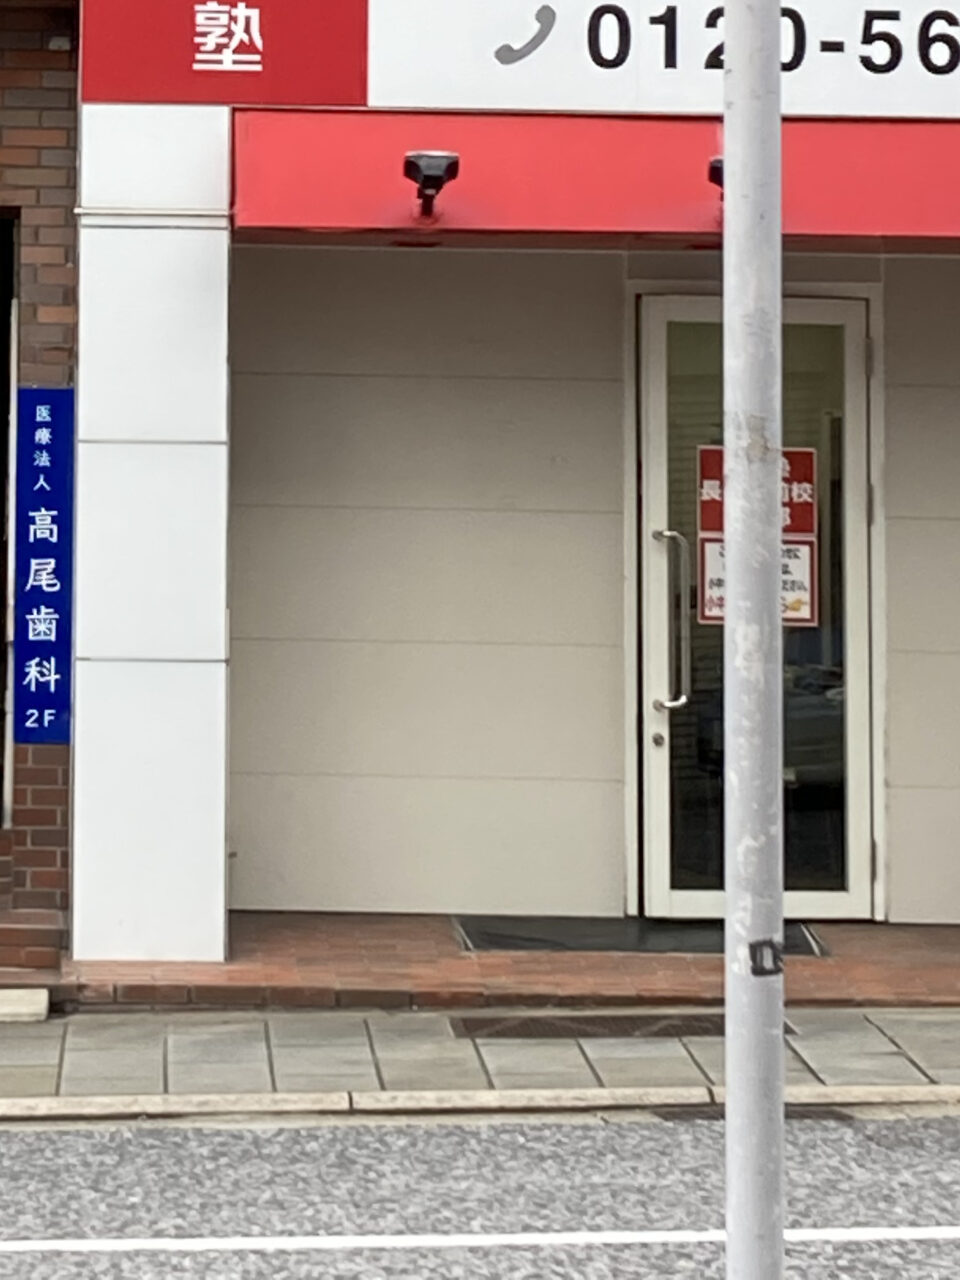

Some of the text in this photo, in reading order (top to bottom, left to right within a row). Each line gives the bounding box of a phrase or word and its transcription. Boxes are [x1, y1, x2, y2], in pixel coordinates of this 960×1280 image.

[23, 404, 61, 728] 医療法人 高尾歯科 2F
